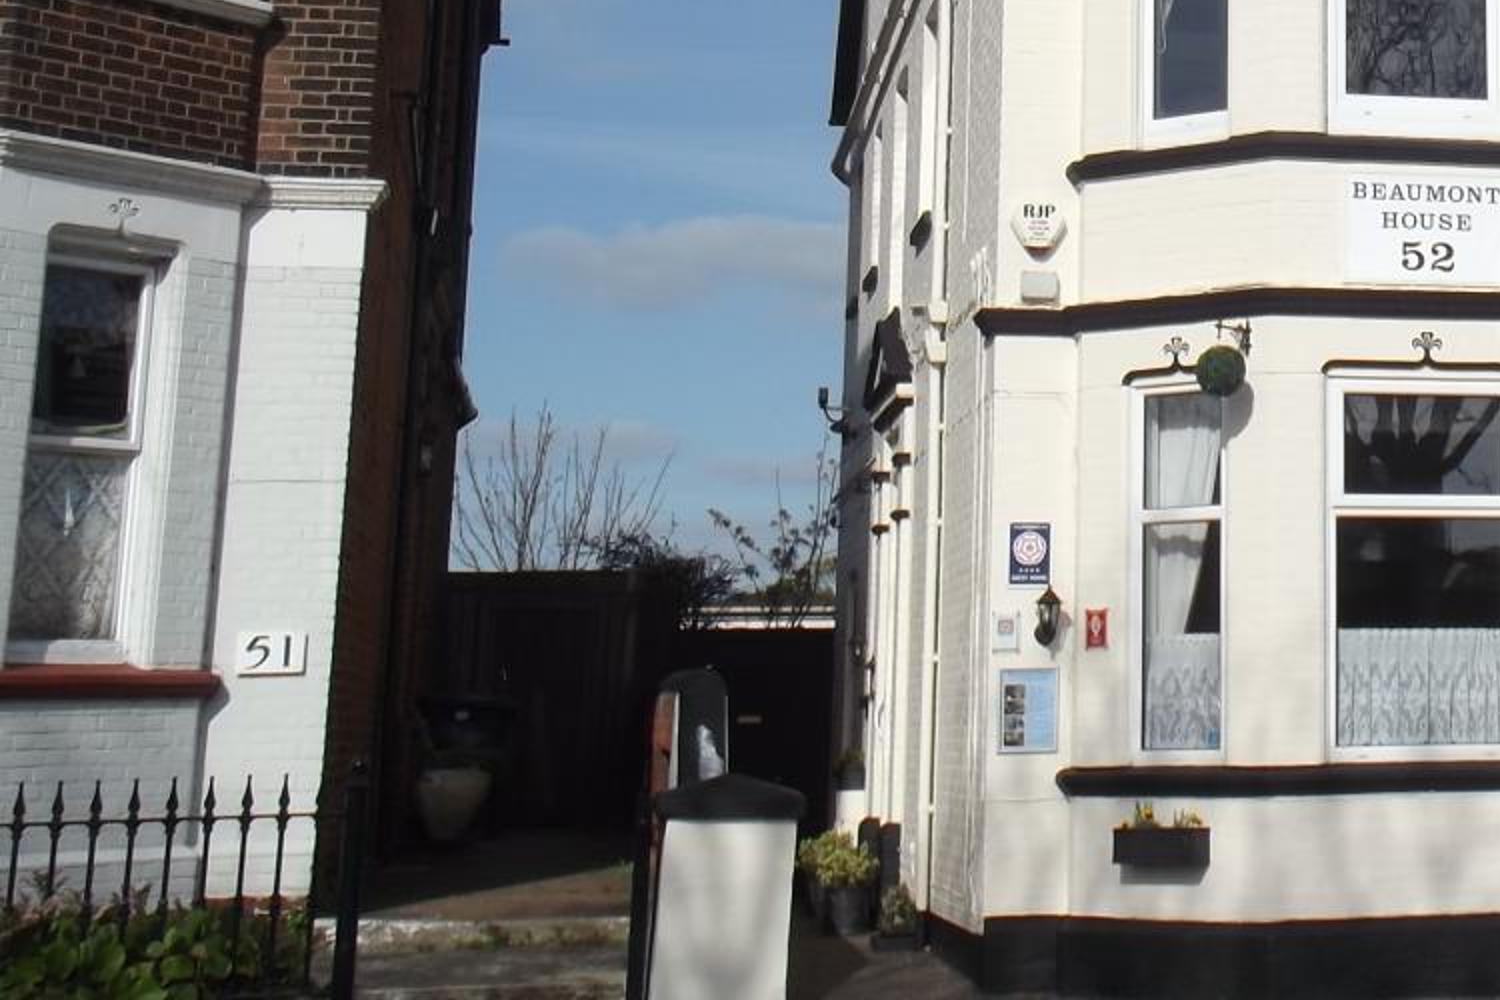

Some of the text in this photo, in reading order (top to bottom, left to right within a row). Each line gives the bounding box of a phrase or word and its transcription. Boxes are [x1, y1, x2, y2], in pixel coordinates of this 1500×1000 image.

[1353, 181, 1500, 204] BEAUMONT
[1023, 203, 1056, 218] RJP
[1382, 211, 1472, 231] HOUSE
[1401, 241, 1455, 272] 52
[246, 634, 291, 669] 51
